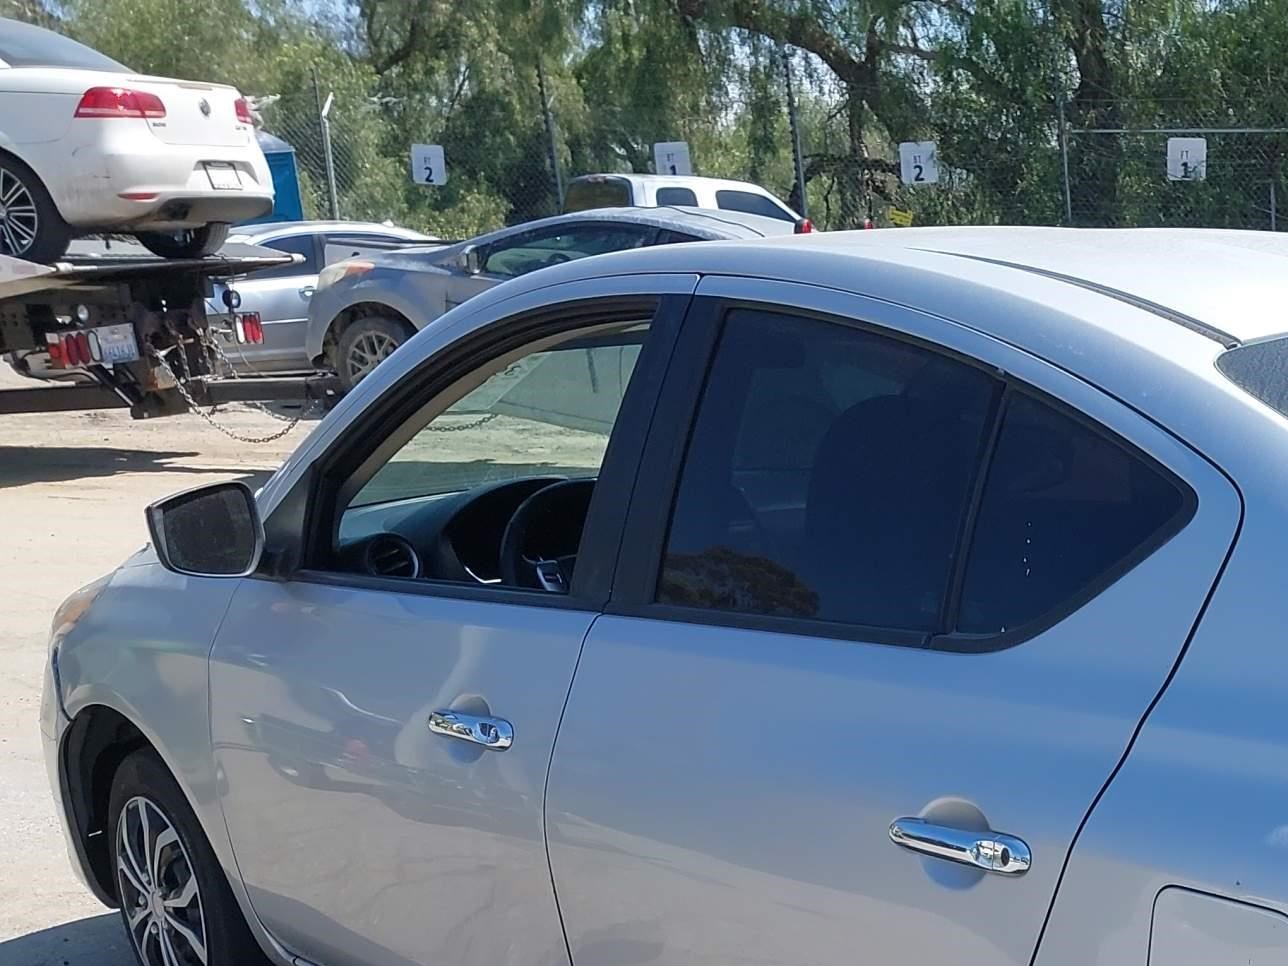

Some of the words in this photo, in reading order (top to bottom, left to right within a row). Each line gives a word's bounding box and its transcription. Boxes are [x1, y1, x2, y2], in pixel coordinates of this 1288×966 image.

[424, 166, 434, 183] 2
[670, 164, 677, 176] 1
[913, 164, 925, 182] 2
[1181, 161, 1192, 179] 1
